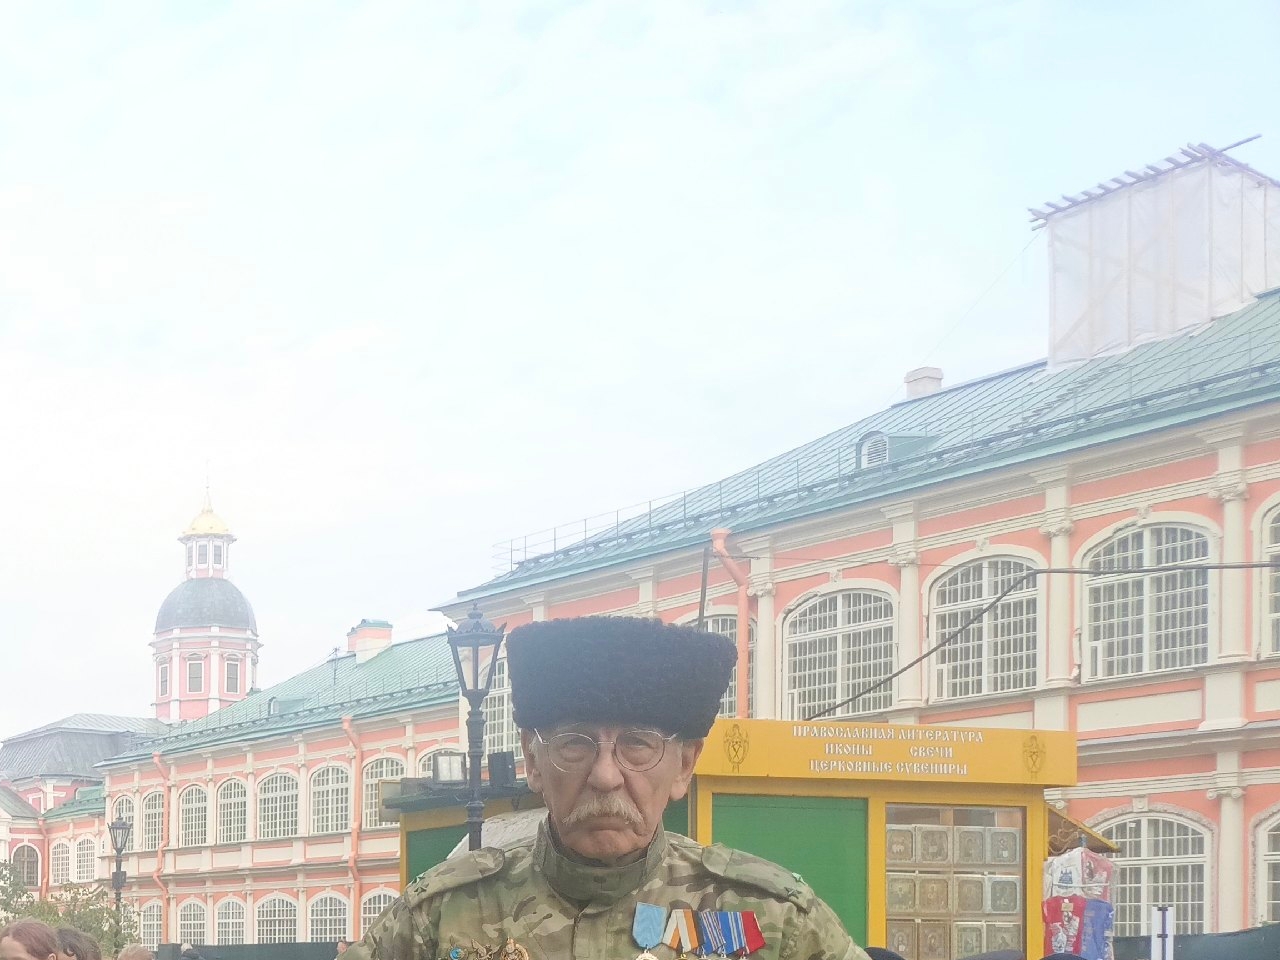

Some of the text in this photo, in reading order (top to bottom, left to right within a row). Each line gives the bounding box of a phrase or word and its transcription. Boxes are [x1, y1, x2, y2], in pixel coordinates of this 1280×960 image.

[792, 725, 984, 743] ПРАВОСЛАВНАЯ ЛИТЕРАТУРА
[825, 743, 873, 755] ИКОНЫ
[909, 745, 953, 758] СВЕЧИ
[810, 759, 967, 775] ЦЕРКОВНЫЕ СУВЕНИРЫ
